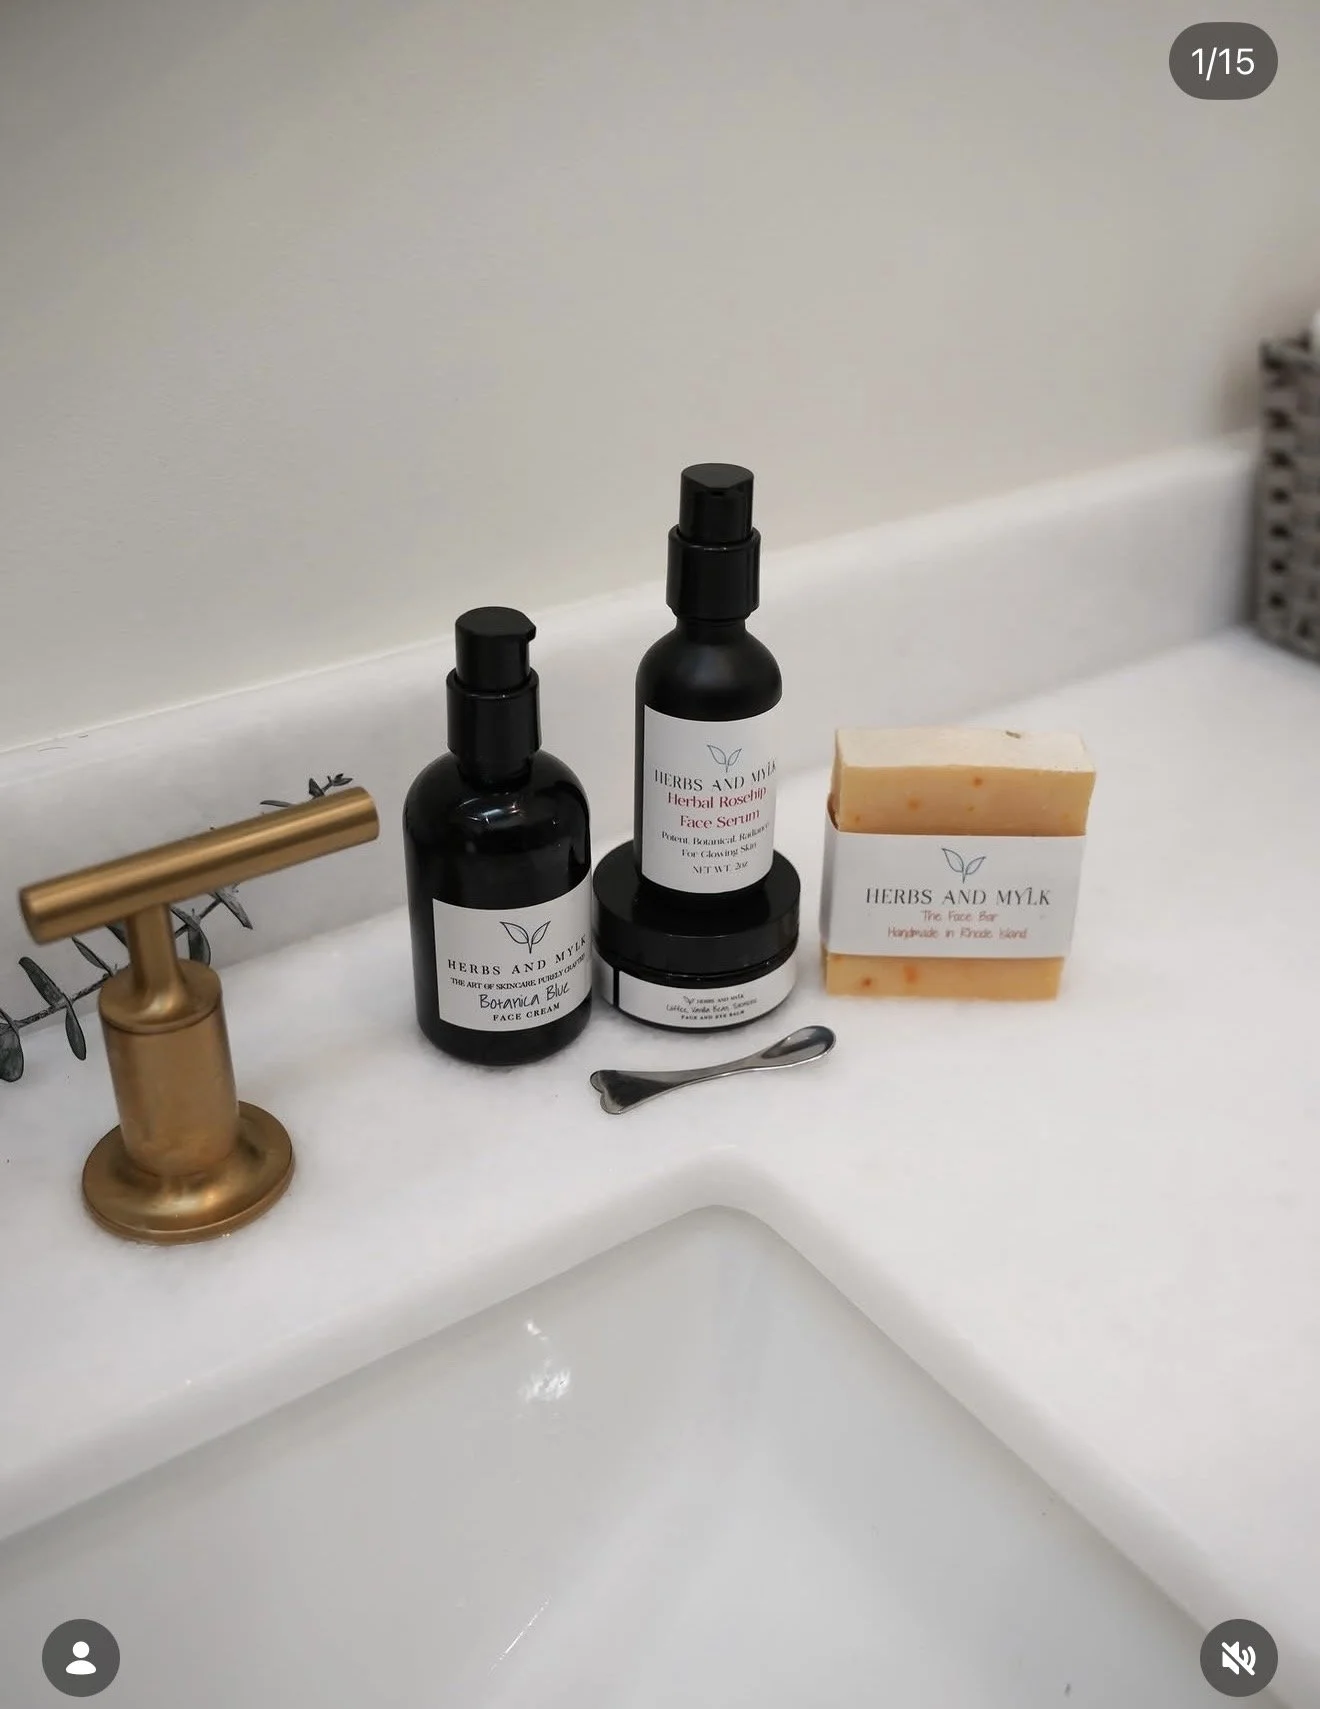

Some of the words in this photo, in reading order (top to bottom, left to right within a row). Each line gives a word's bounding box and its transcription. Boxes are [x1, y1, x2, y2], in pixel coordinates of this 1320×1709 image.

[655, 769, 703, 791] HERBS
[712, 776, 745, 791] AND
[668, 792, 714, 809] Herbal
[719, 787, 767, 808] Rosehip
[680, 815, 712, 829] Face
[716, 809, 760, 829] Serum
[682, 849, 697, 857] For
[701, 848, 738, 858] Glowing
[741, 842, 757, 852] Skin
[693, 865, 712, 874] NET
[866, 888, 933, 905] HERBS
[942, 889, 987, 905] AND
[996, 887, 1051, 905] MYLK
[922, 910, 942, 922] The
[948, 910, 973, 922] Face
[979, 910, 998, 922] Bar
[887, 927, 939, 939] Handmade
[945, 928, 954, 939] in
[960, 927, 993, 939] Rhode
[999, 928, 1028, 939] Island
[448, 958, 501, 975] HERBS
[511, 959, 546, 975] AND
[555, 934, 586, 964] MYLK
[451, 977, 465, 987] THE
[466, 980, 482, 989] ART
[538, 971, 563, 985] PURELY
[479, 994, 540, 1009] Botanica
[546, 982, 570, 1001] Blue
[493, 1014, 522, 1022] FACE
[526, 1003, 560, 1018] CREAM
